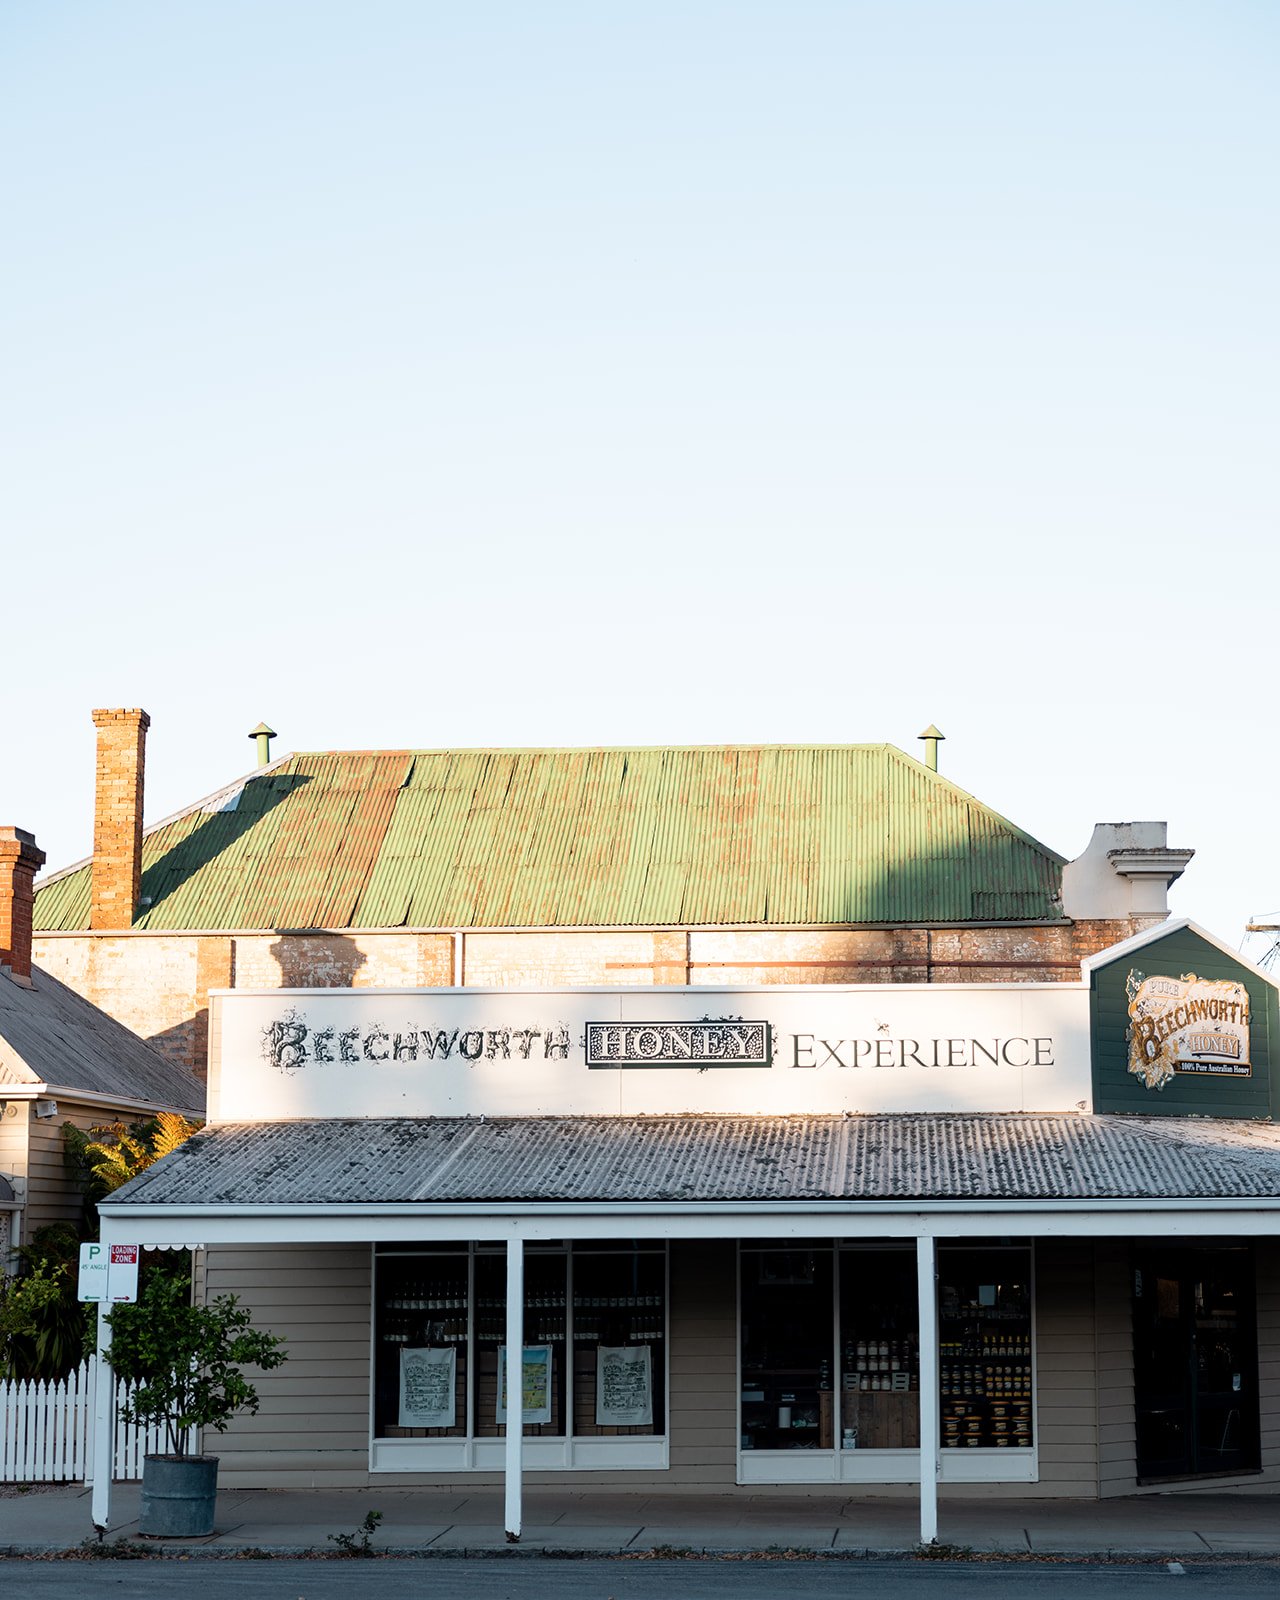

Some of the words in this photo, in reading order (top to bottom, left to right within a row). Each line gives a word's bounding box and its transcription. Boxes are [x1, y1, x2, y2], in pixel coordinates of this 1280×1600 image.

[1149, 980, 1180, 997] PURE
[1132, 999, 1249, 1063] BEECHWORTH
[270, 1017, 570, 1068] BEECHWORTH
[600, 1028, 757, 1059] HONEY
[789, 1033, 1055, 1069] EXPERIENCE
[1191, 1035, 1237, 1056] HONEY
[1181, 1062, 1195, 1071] 100%
[1195, 1063, 1207, 1072] Pure
[1208, 1064, 1233, 1073] Australian
[1233, 1066, 1250, 1075] Honey
[89, 1246, 101, 1260] P
[112, 1246, 137, 1255] LOADING
[114, 1255, 133, 1263] ZONE
